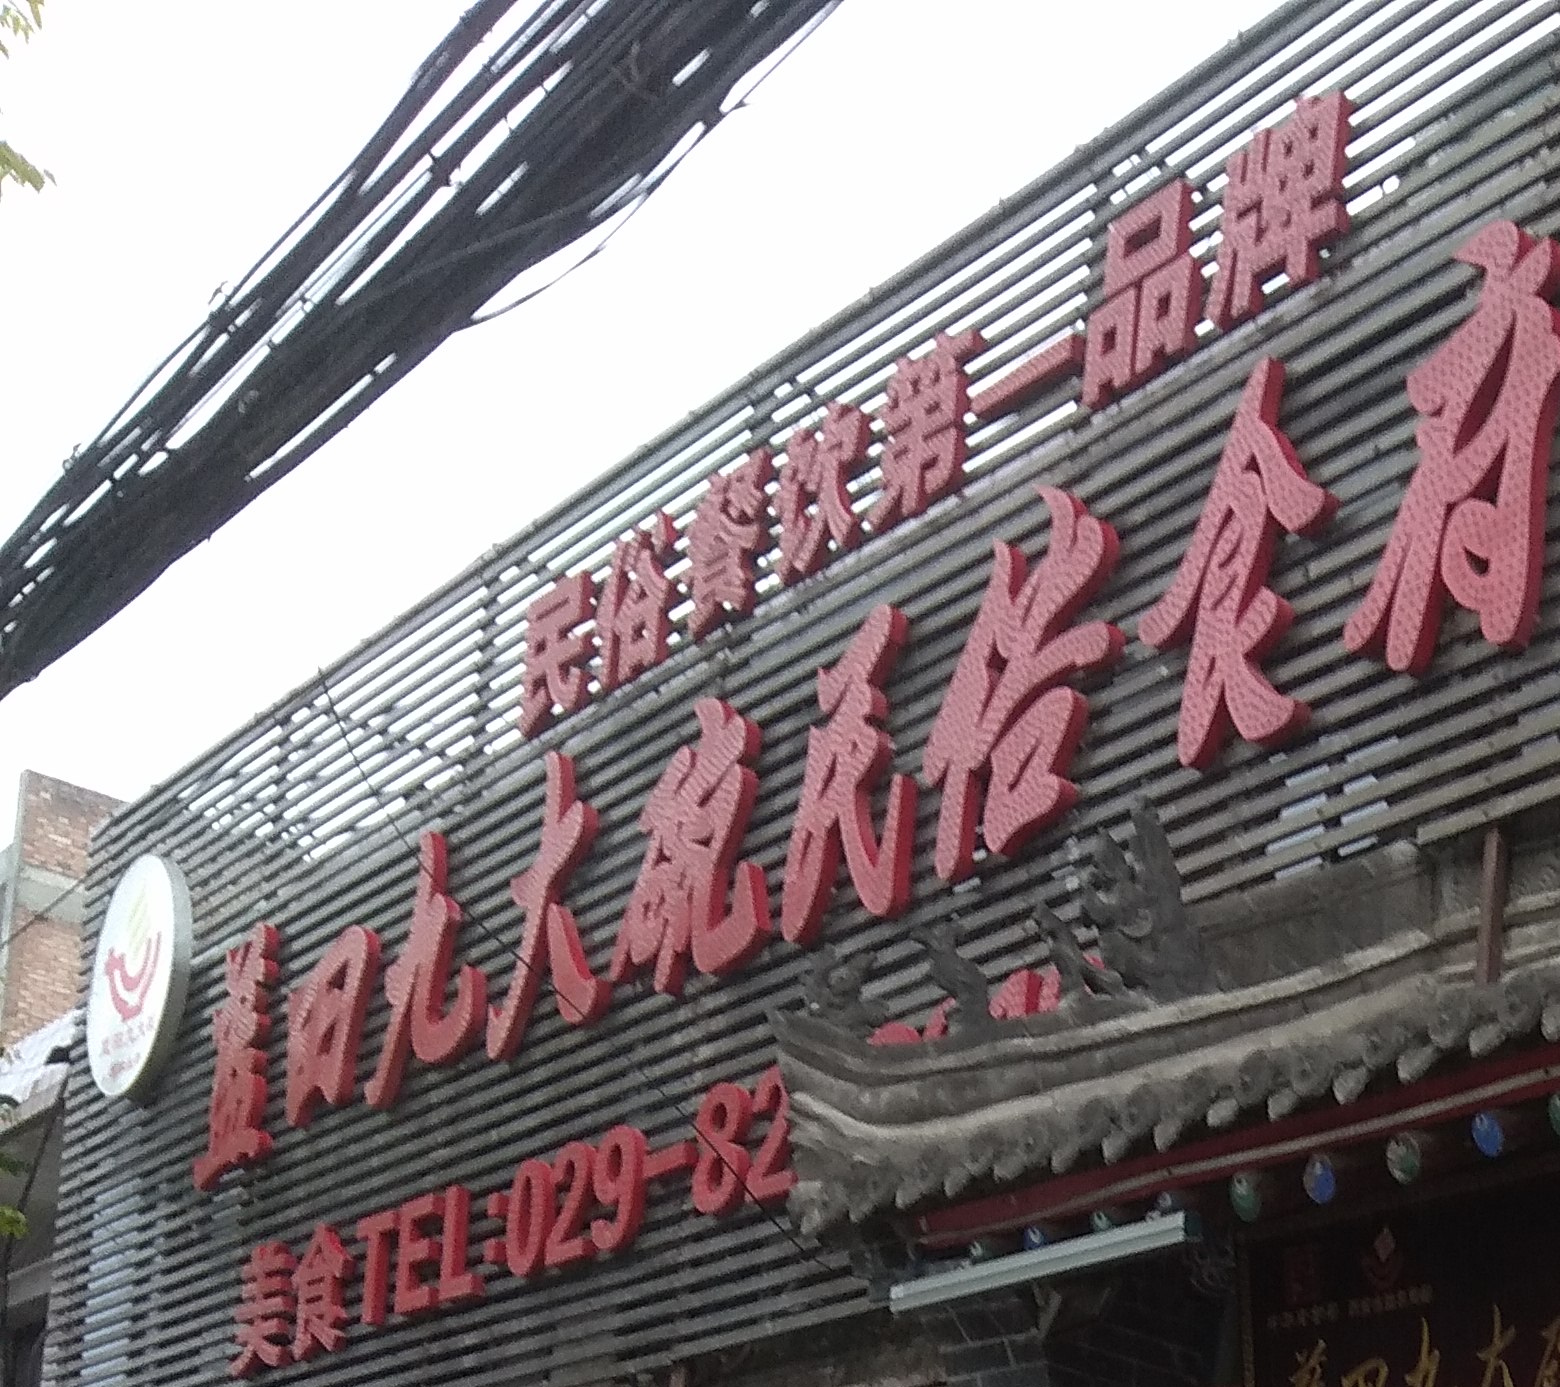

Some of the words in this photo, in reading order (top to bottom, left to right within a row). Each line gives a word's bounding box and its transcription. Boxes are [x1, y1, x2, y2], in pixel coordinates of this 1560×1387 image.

[520, 91, 1352, 738] 民俗餐饮第一品牌
